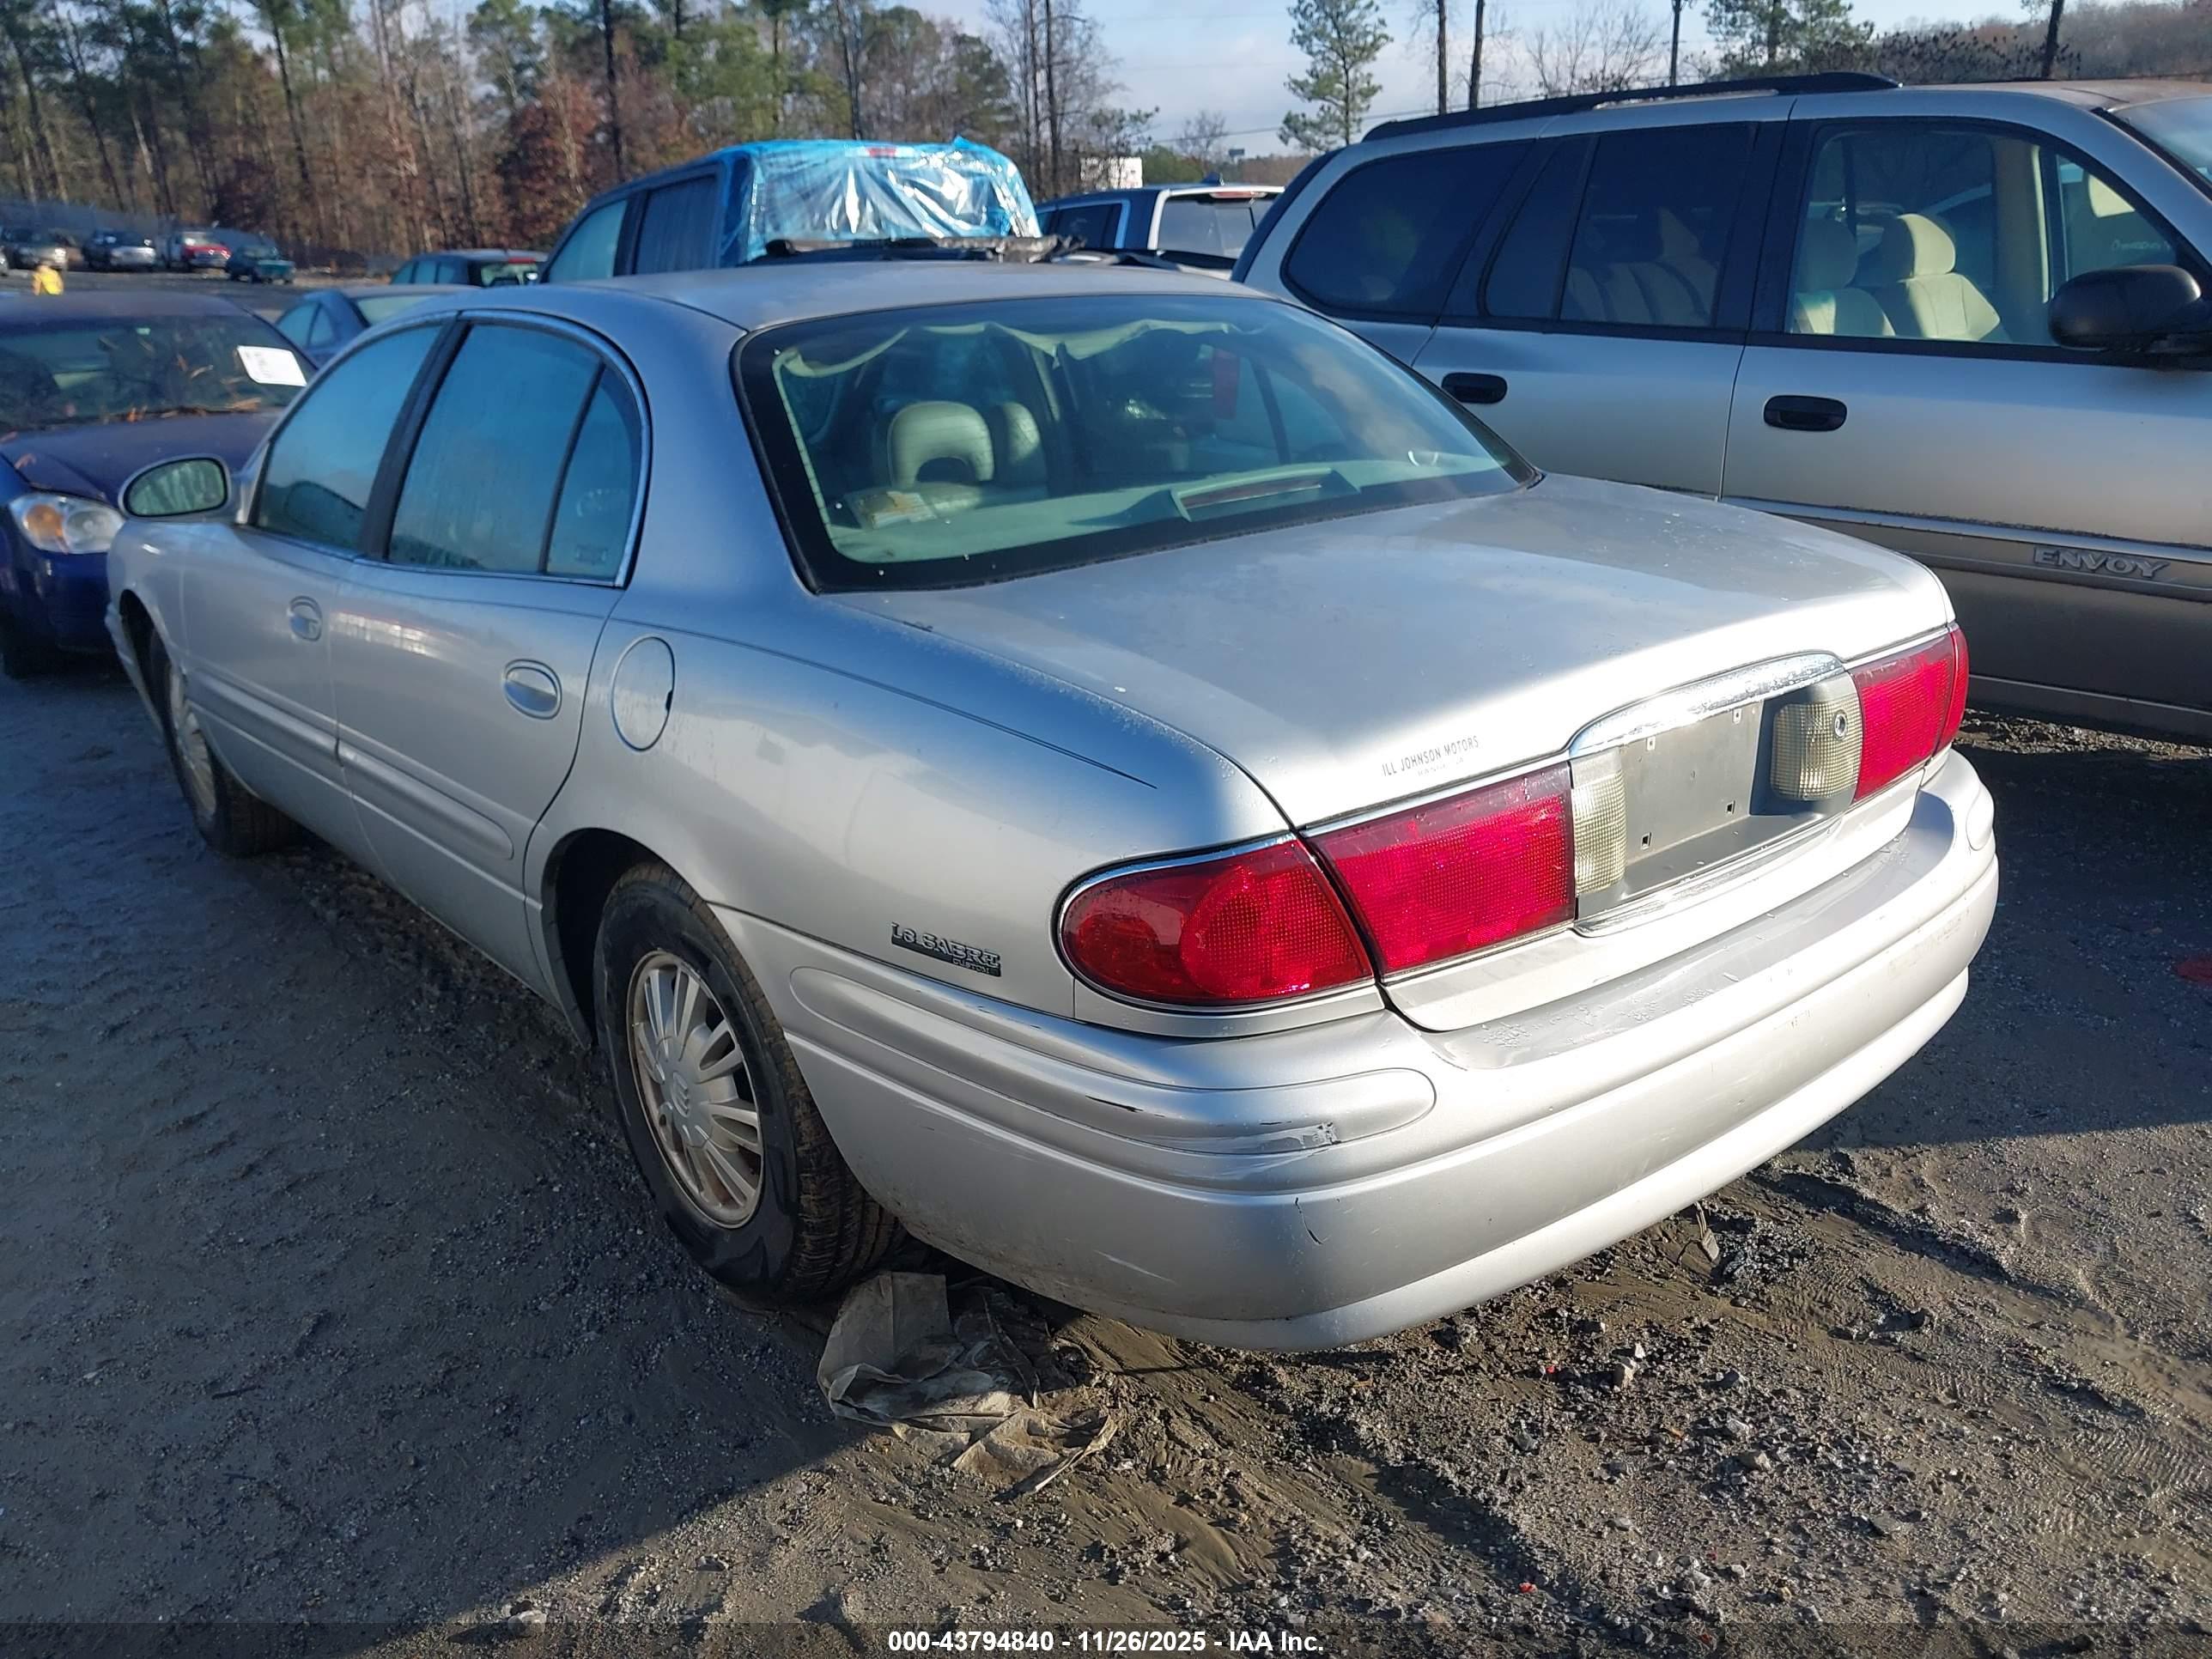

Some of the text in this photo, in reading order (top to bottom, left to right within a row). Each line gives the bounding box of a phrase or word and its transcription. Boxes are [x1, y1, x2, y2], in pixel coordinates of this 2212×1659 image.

[2033, 547, 2170, 578] ENVOY
[1401, 748, 1442, 771] JOHNSON
[1443, 735, 1480, 756] MOTORS
